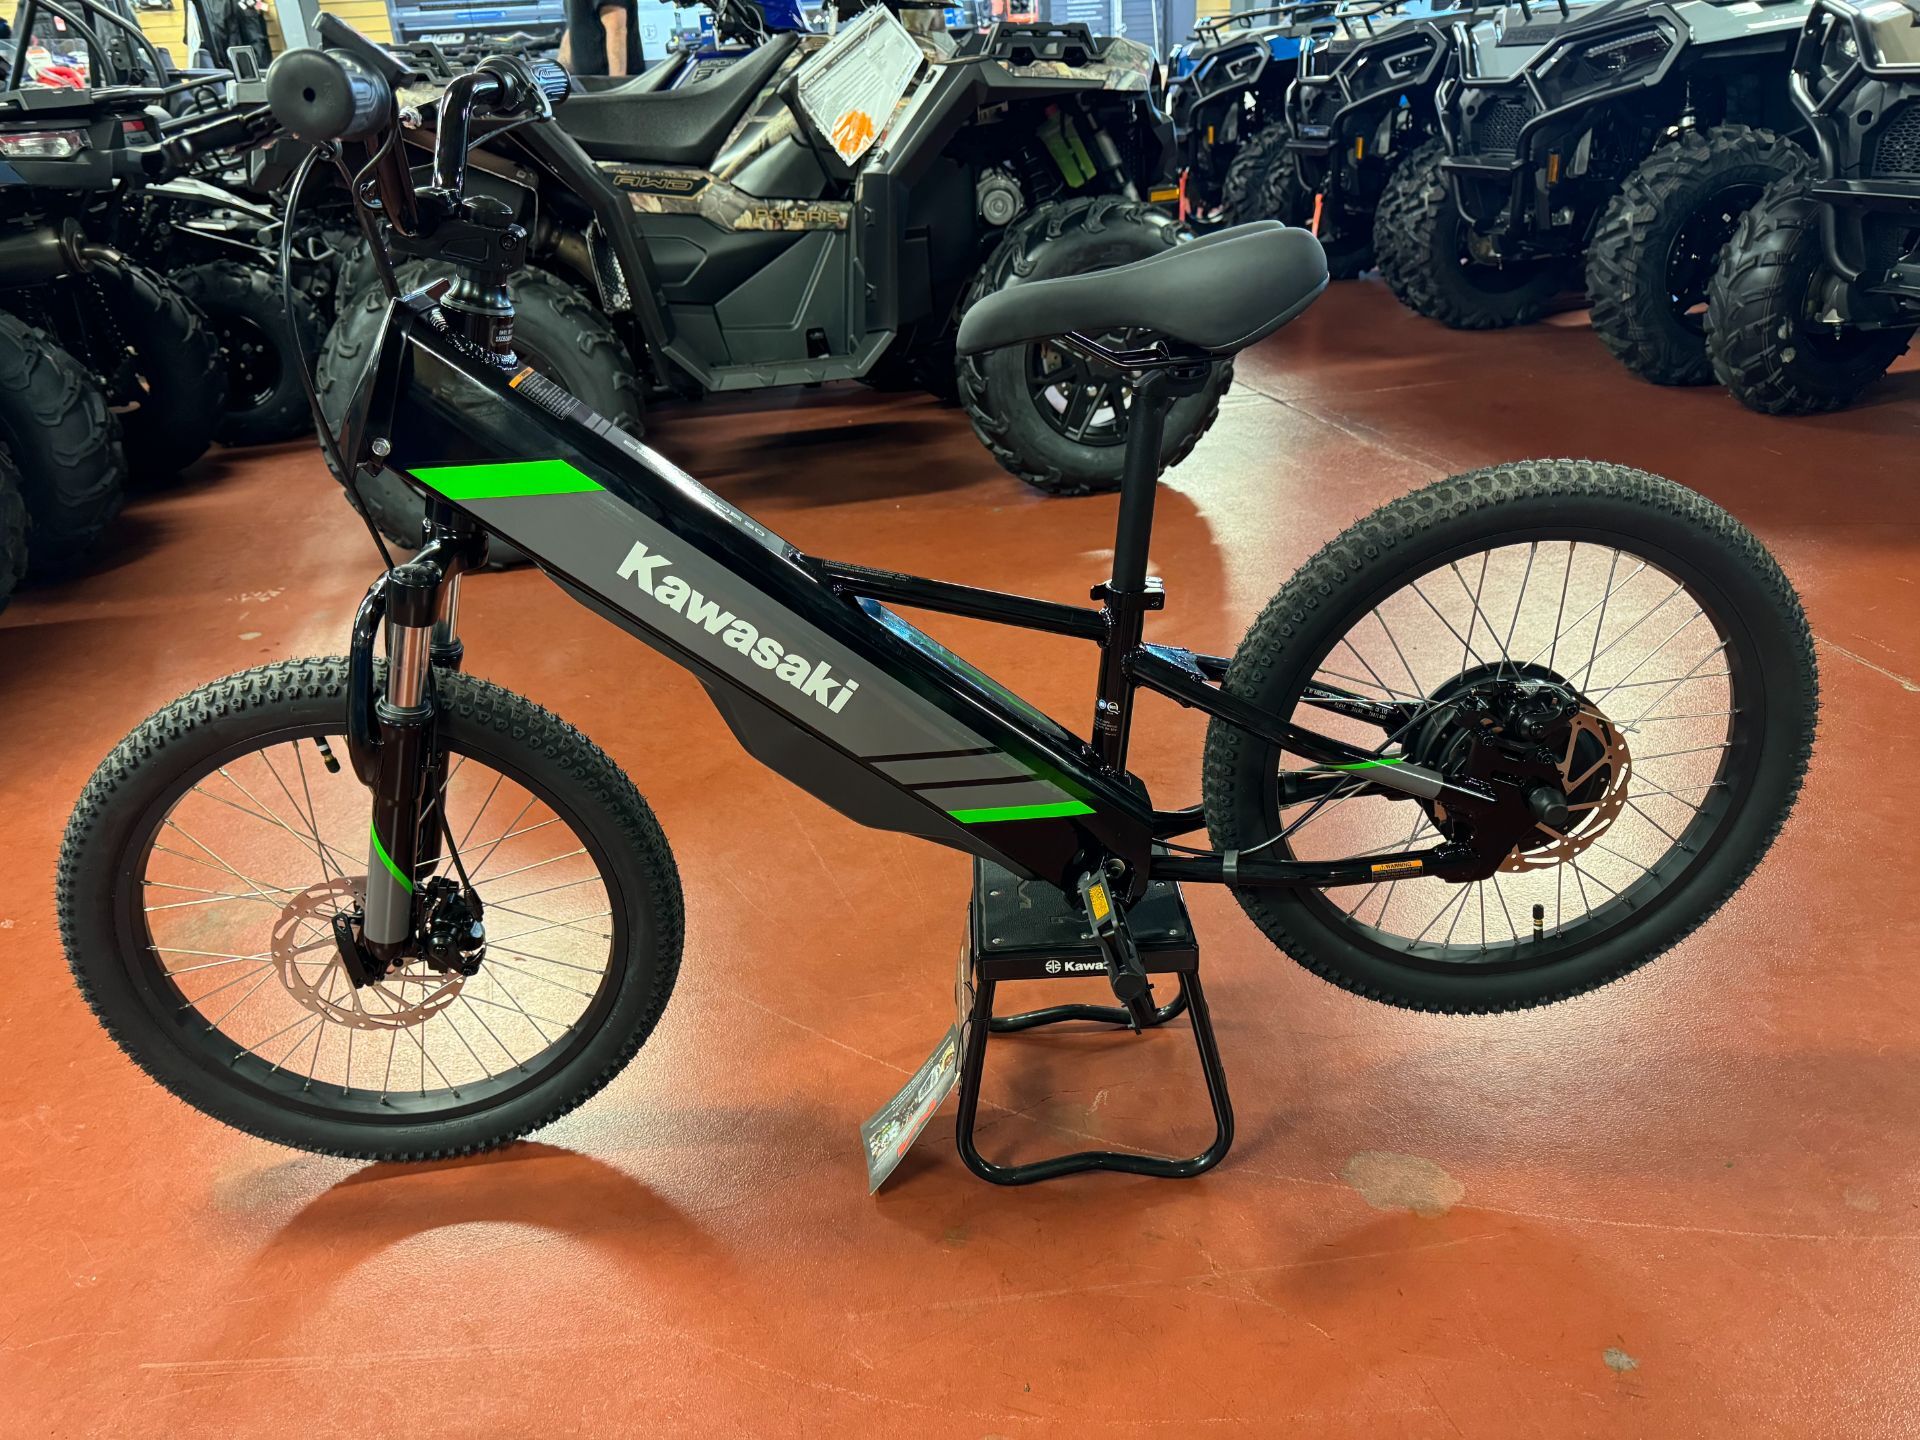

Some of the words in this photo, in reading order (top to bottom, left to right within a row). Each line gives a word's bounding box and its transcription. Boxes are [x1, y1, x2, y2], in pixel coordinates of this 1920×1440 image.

[613, 175, 693, 191] AWD
[754, 208, 841, 223] POLARIS
[616, 540, 860, 715] Kawasaki
